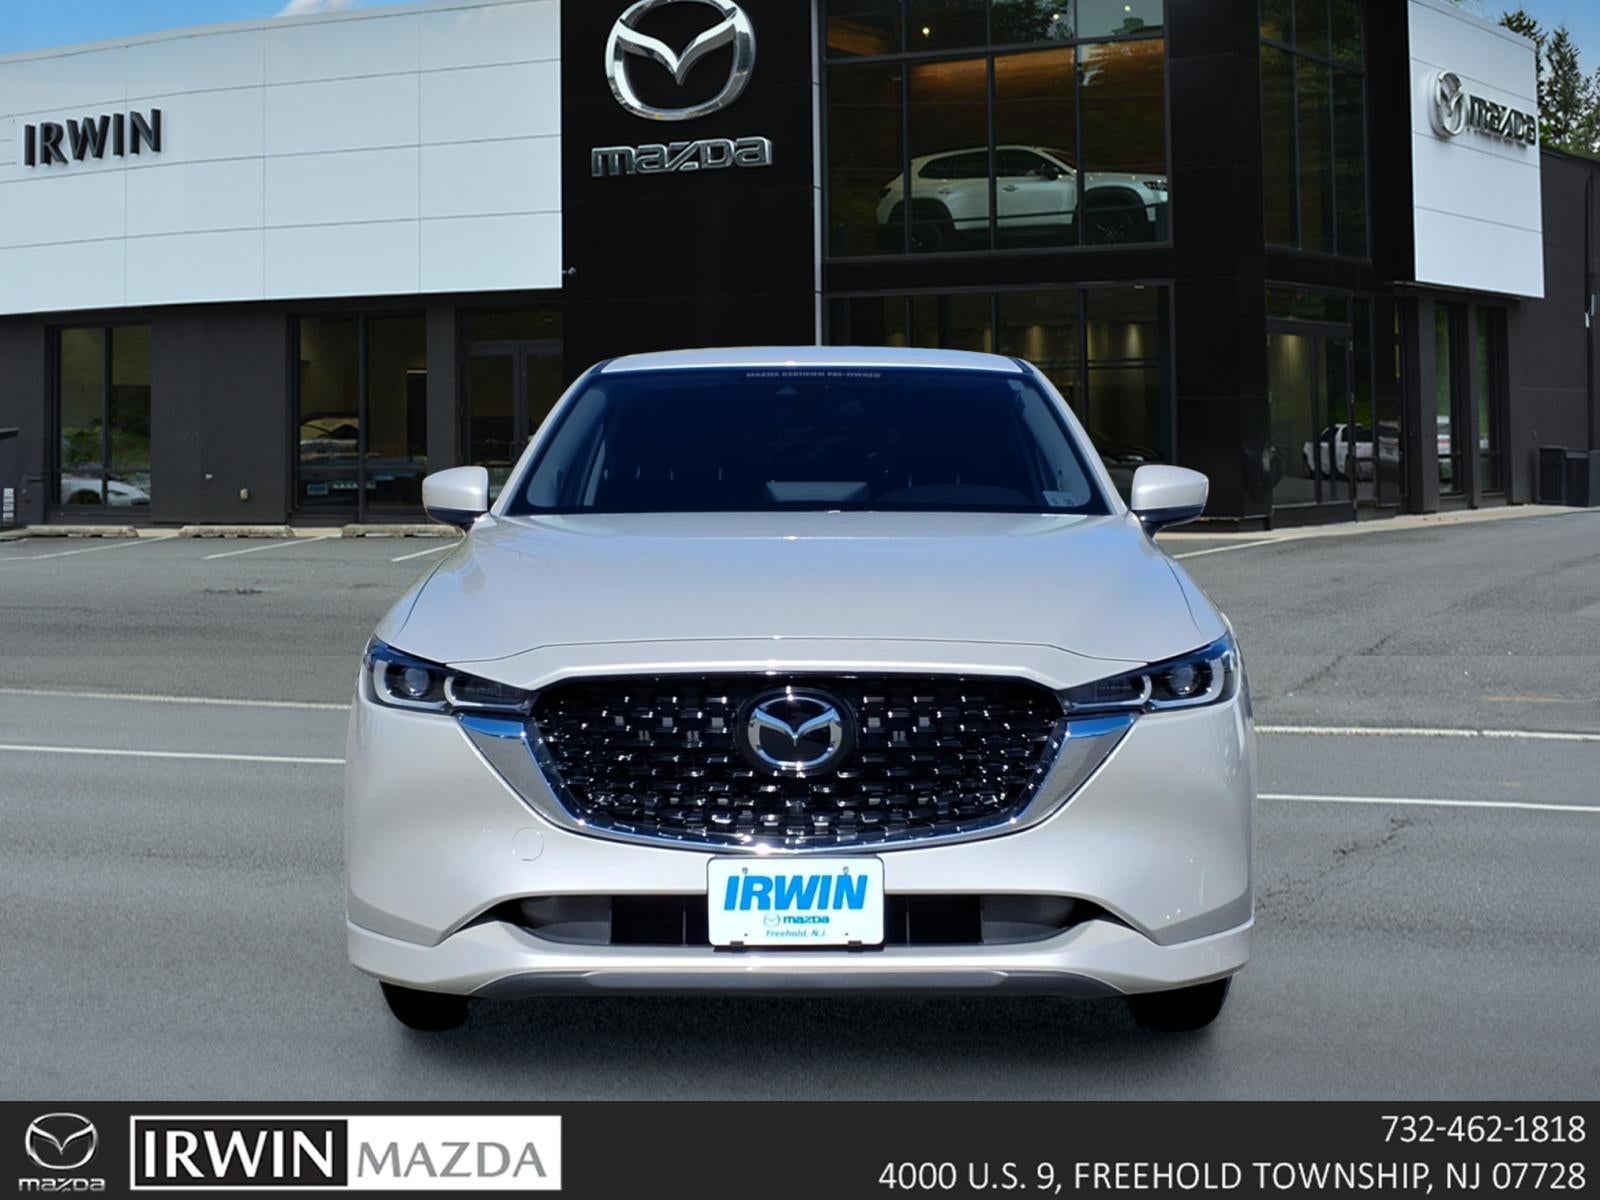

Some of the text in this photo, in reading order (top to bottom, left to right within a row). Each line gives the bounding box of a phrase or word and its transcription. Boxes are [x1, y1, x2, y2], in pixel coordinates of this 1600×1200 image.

[24, 108, 162, 168] IRWIN
[1468, 94, 1537, 147] mazda
[591, 135, 773, 178] mazda
[723, 874, 869, 911] IRWIN
[765, 928, 809, 938] Freehold,
[783, 915, 830, 924] mazda
